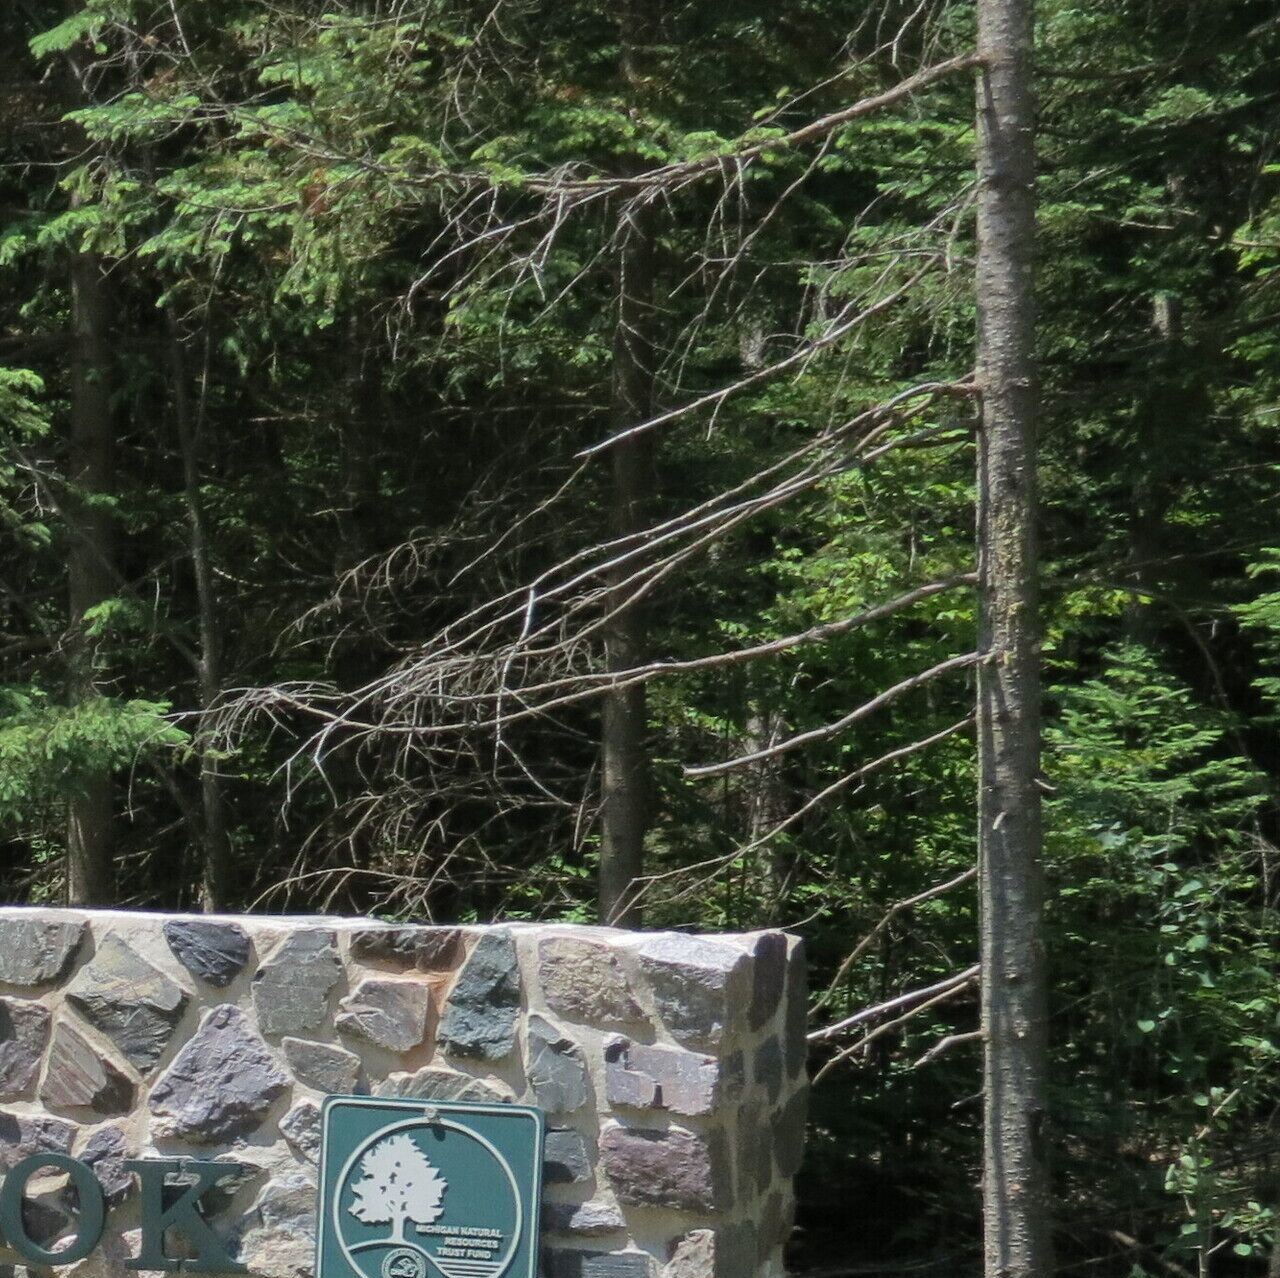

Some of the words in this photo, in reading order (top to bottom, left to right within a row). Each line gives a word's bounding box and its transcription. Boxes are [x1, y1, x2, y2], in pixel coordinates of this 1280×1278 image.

[416, 1224, 460, 1235] MICHIGAN
[460, 1227, 502, 1238] NATURAL
[444, 1237, 498, 1248] RESOURCES
[436, 1246, 466, 1257] TRUST
[467, 1248, 492, 1259] FUND
